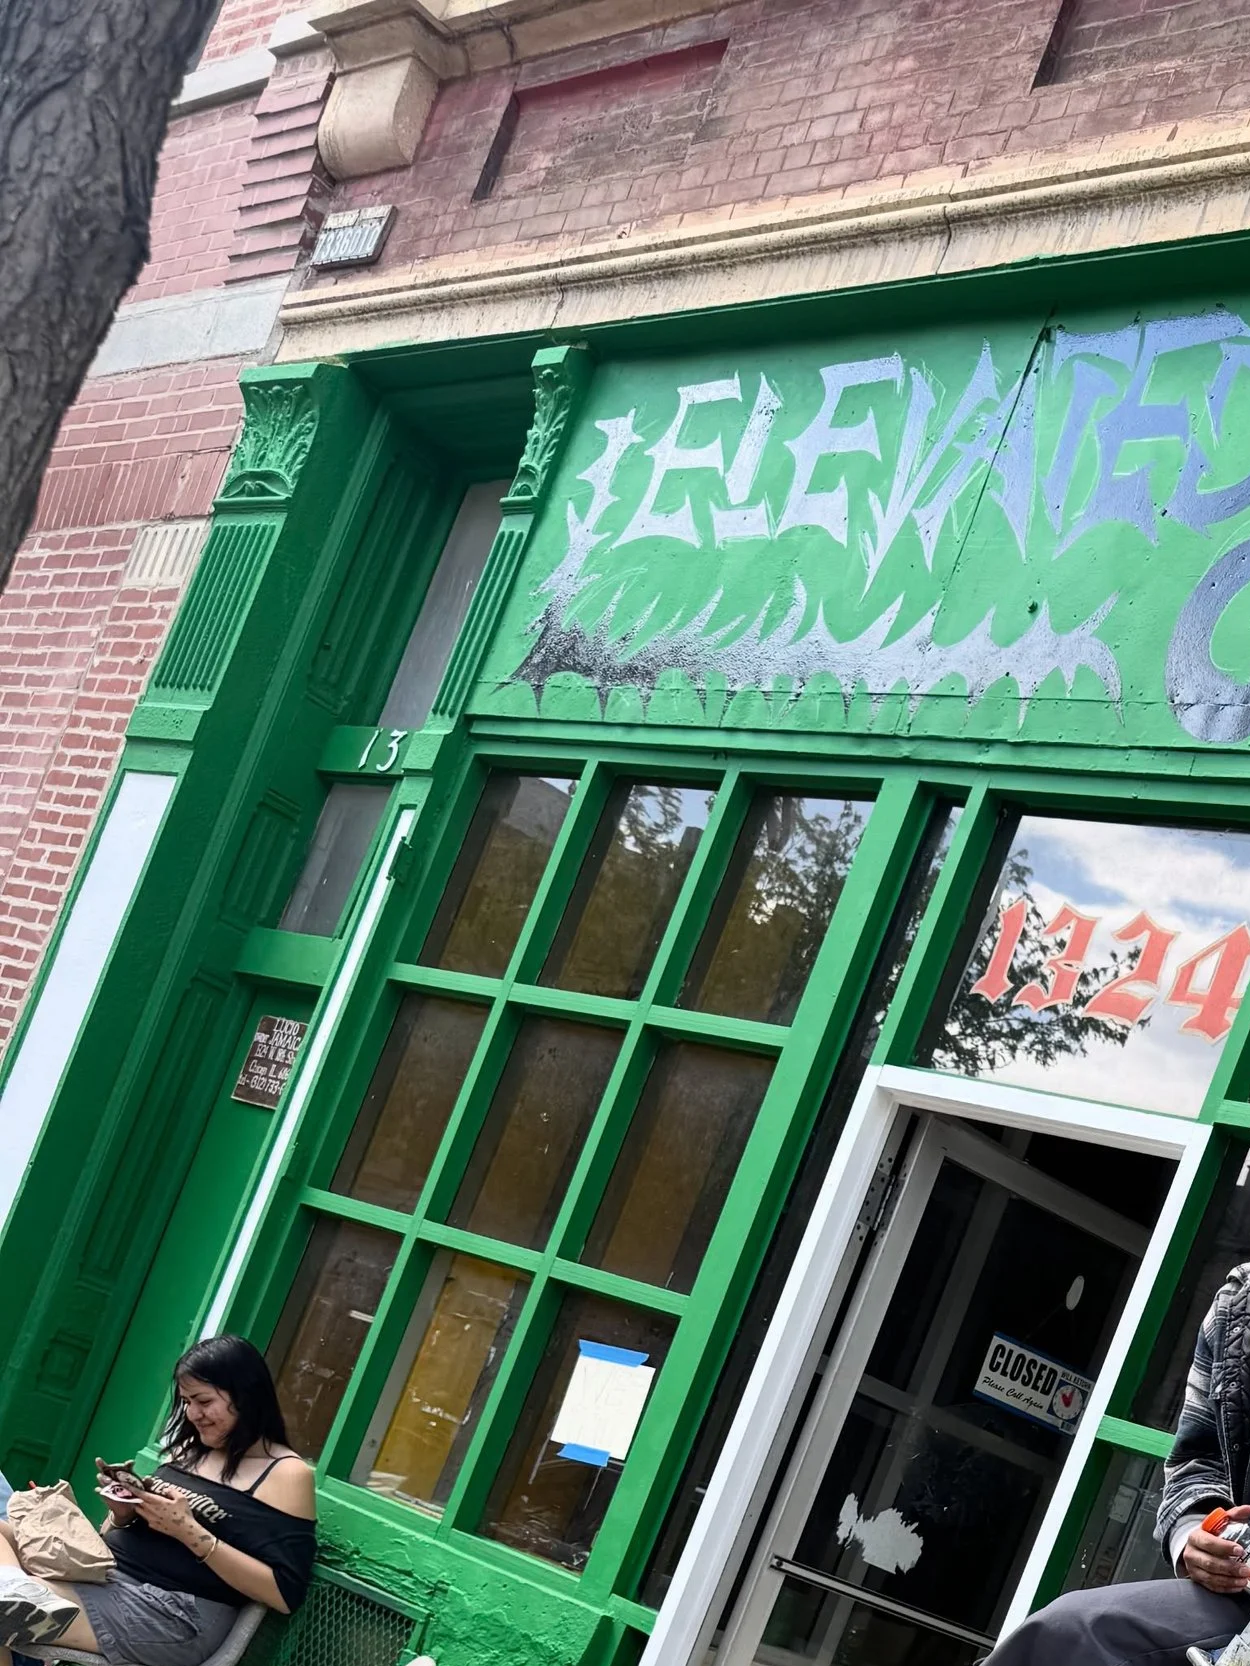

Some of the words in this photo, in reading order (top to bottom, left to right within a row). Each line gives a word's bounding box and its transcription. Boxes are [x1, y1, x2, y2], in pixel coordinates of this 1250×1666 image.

[269, 1031, 303, 1051] JAMAIC
[988, 1343, 1058, 1396] CLOSED
[981, 1376, 1006, 1393] Please
[1005, 1387, 1024, 1403] Call
[1021, 1396, 1044, 1411] Again
